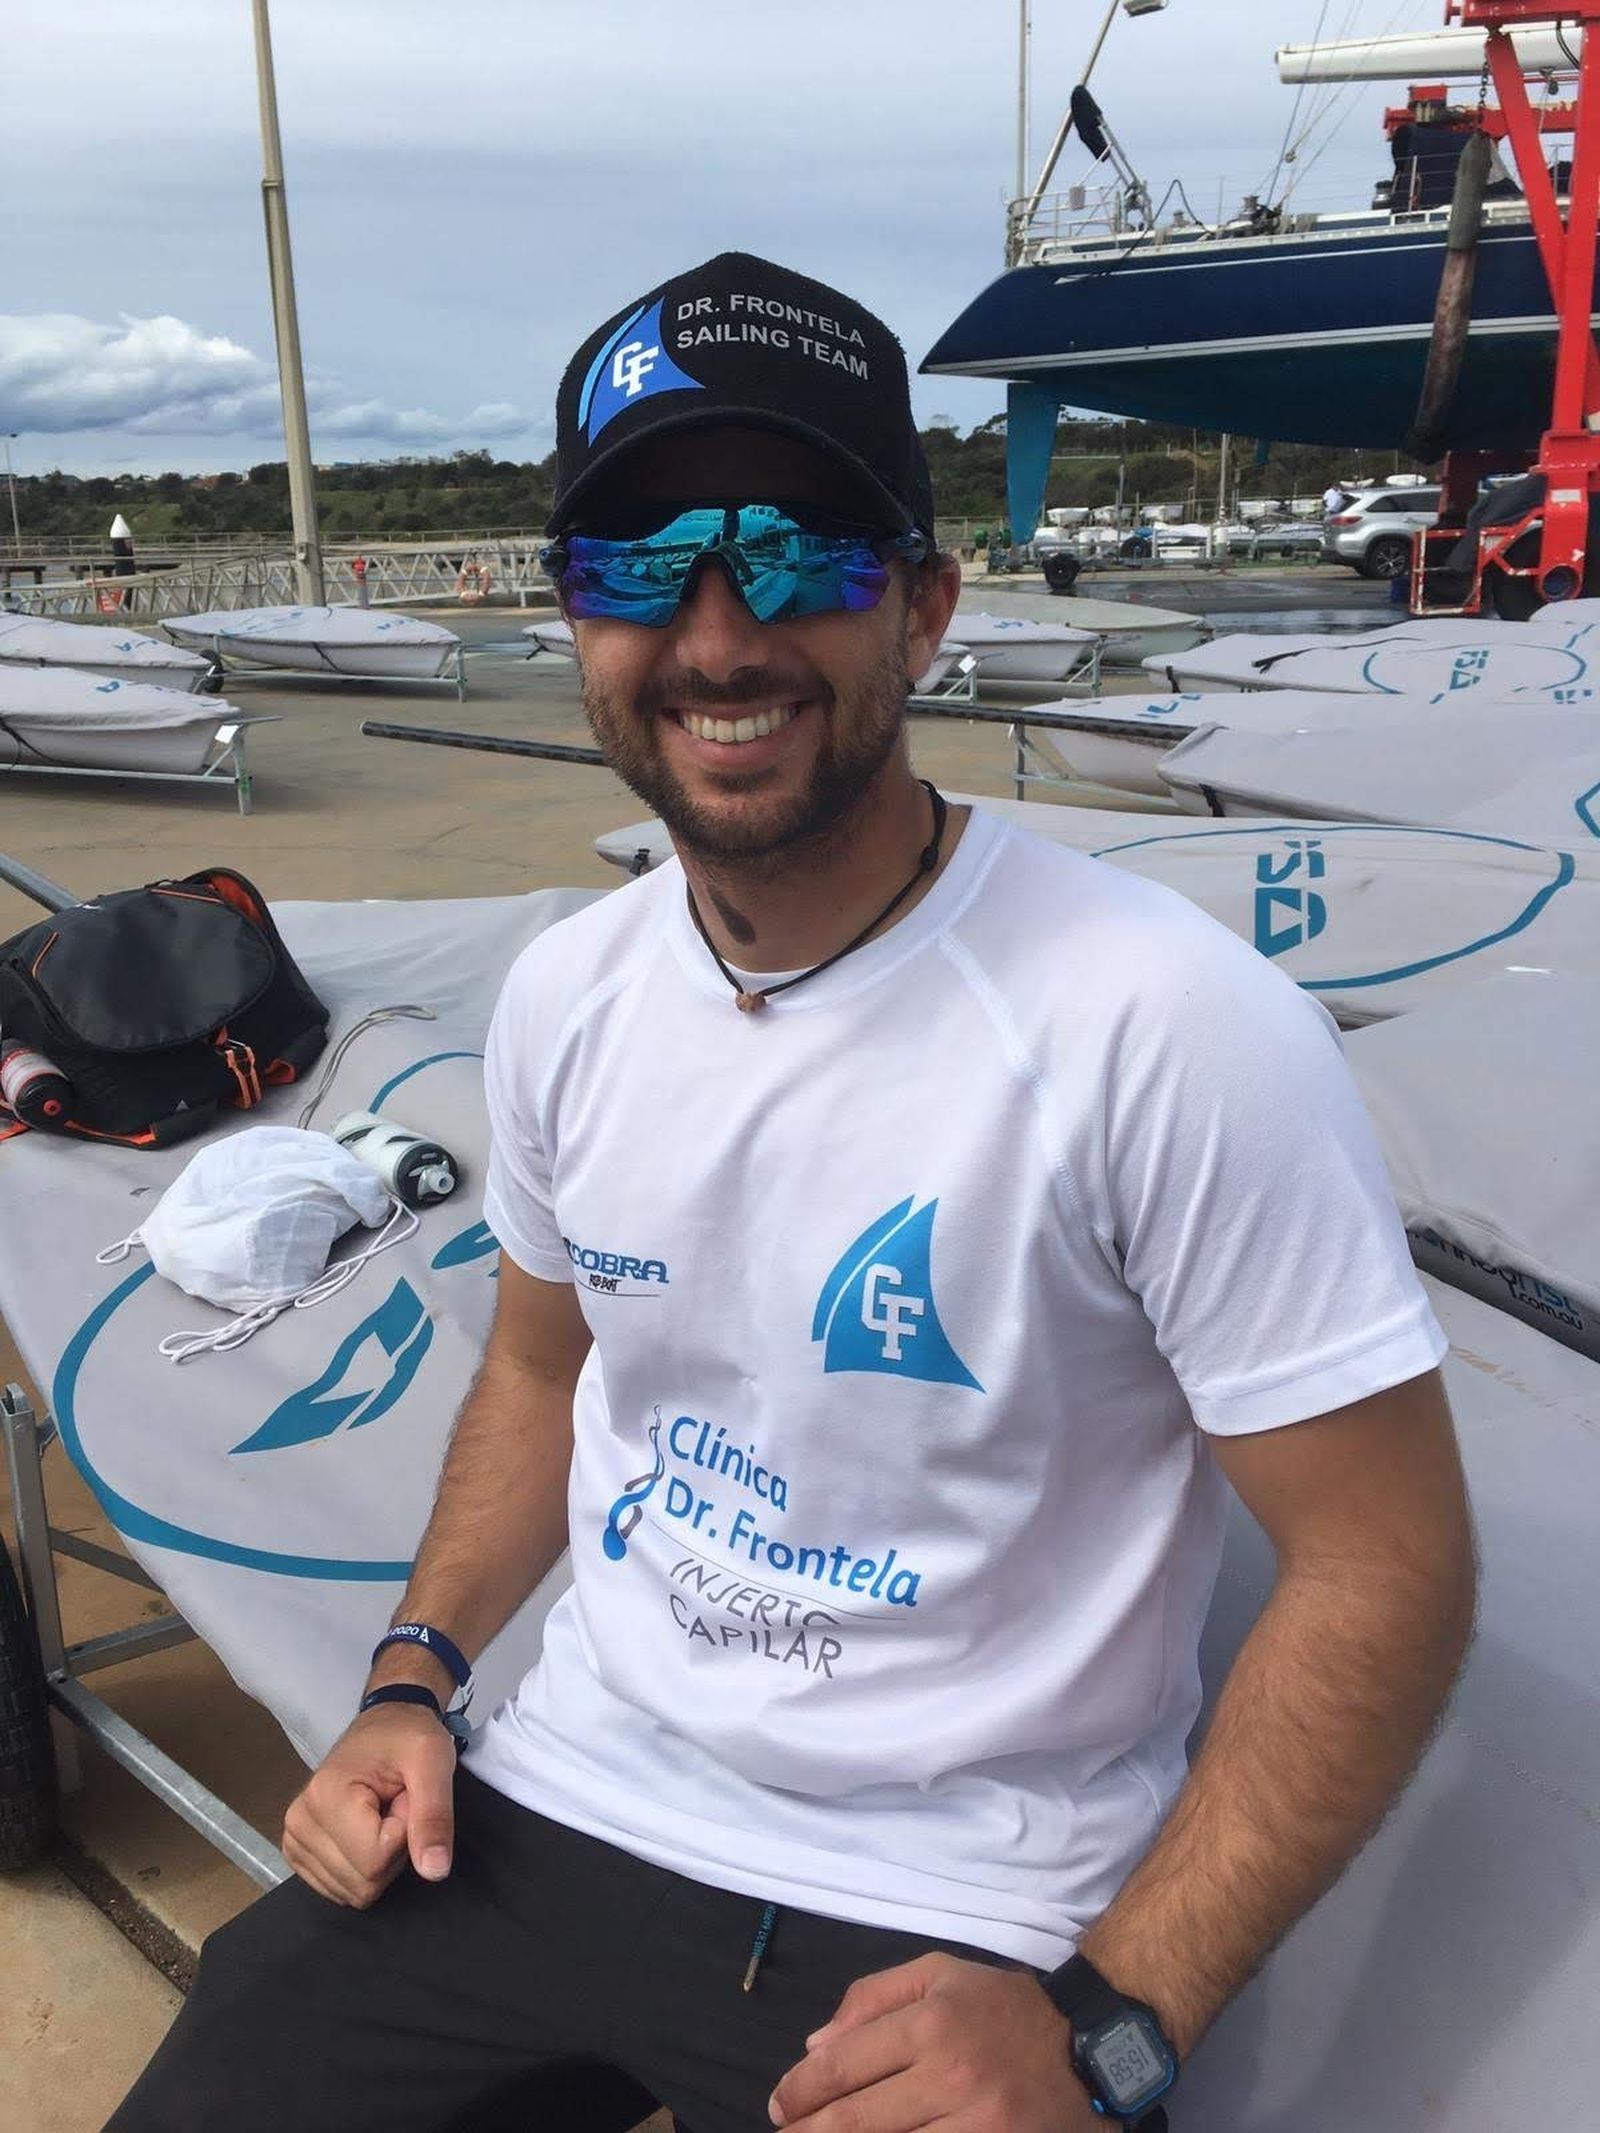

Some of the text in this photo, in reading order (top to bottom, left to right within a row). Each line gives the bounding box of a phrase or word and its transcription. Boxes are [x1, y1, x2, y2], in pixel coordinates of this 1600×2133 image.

[676, 323, 869, 380] SAILING TEAM
[677, 294, 867, 349] DR. FRONTELA
[572, 1243, 670, 1284] COBRA
[669, 1416, 788, 1512] Clínica
[664, 1475, 922, 1607] Dr. Frontela
[669, 1594, 843, 1680] CAPILAR
